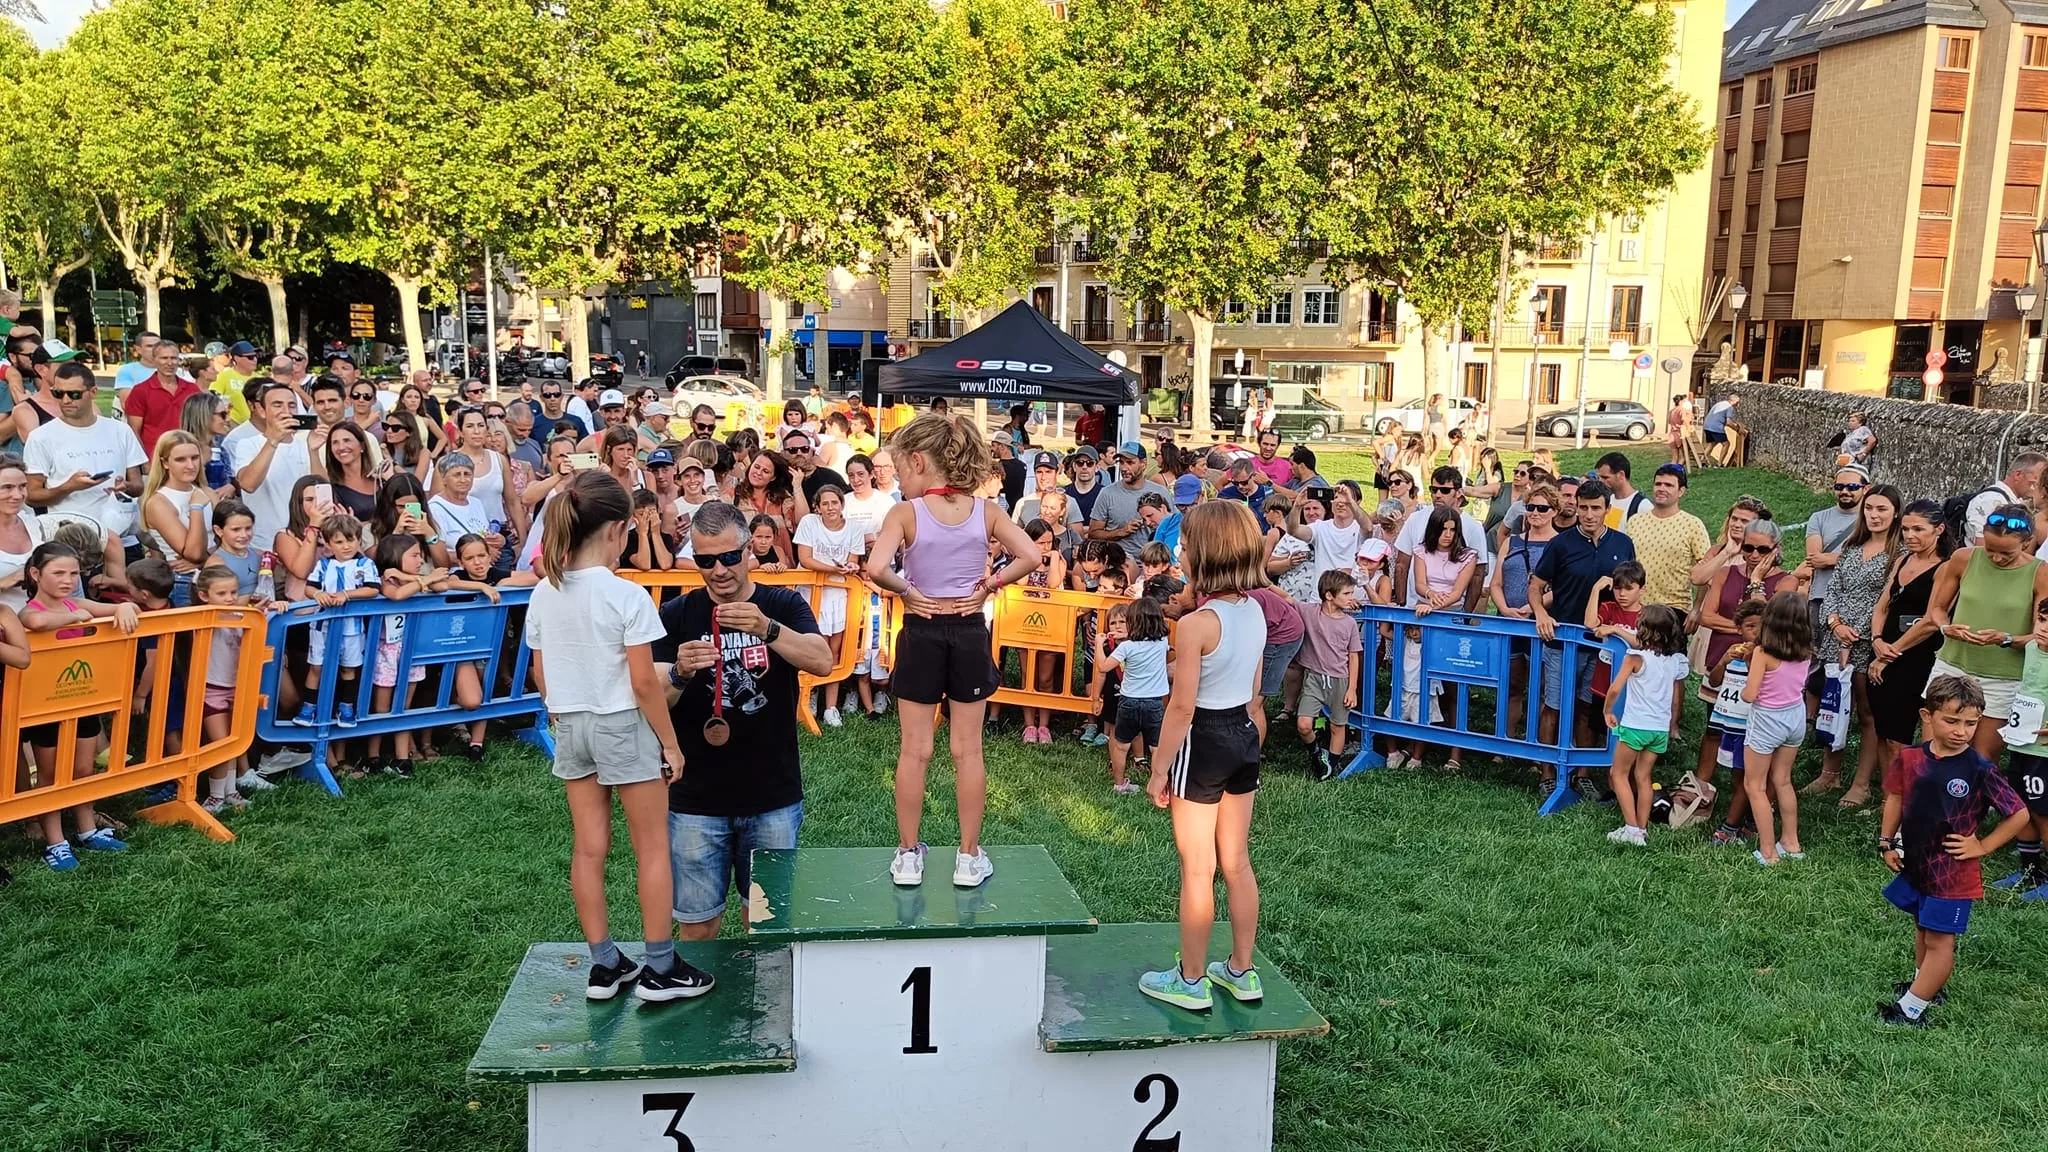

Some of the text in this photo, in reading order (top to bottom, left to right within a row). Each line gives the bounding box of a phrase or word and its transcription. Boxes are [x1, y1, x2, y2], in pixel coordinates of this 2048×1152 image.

[1626, 239, 1637, 259] R
[955, 360, 1054, 374] OS20
[960, 378, 1042, 396] www.OS20.com
[1720, 687, 1740, 704] 44
[2022, 774, 2045, 795] 10
[900, 966, 939, 1055] 1
[642, 1092, 696, 1152] 3
[1133, 1073, 1182, 1152] 2
